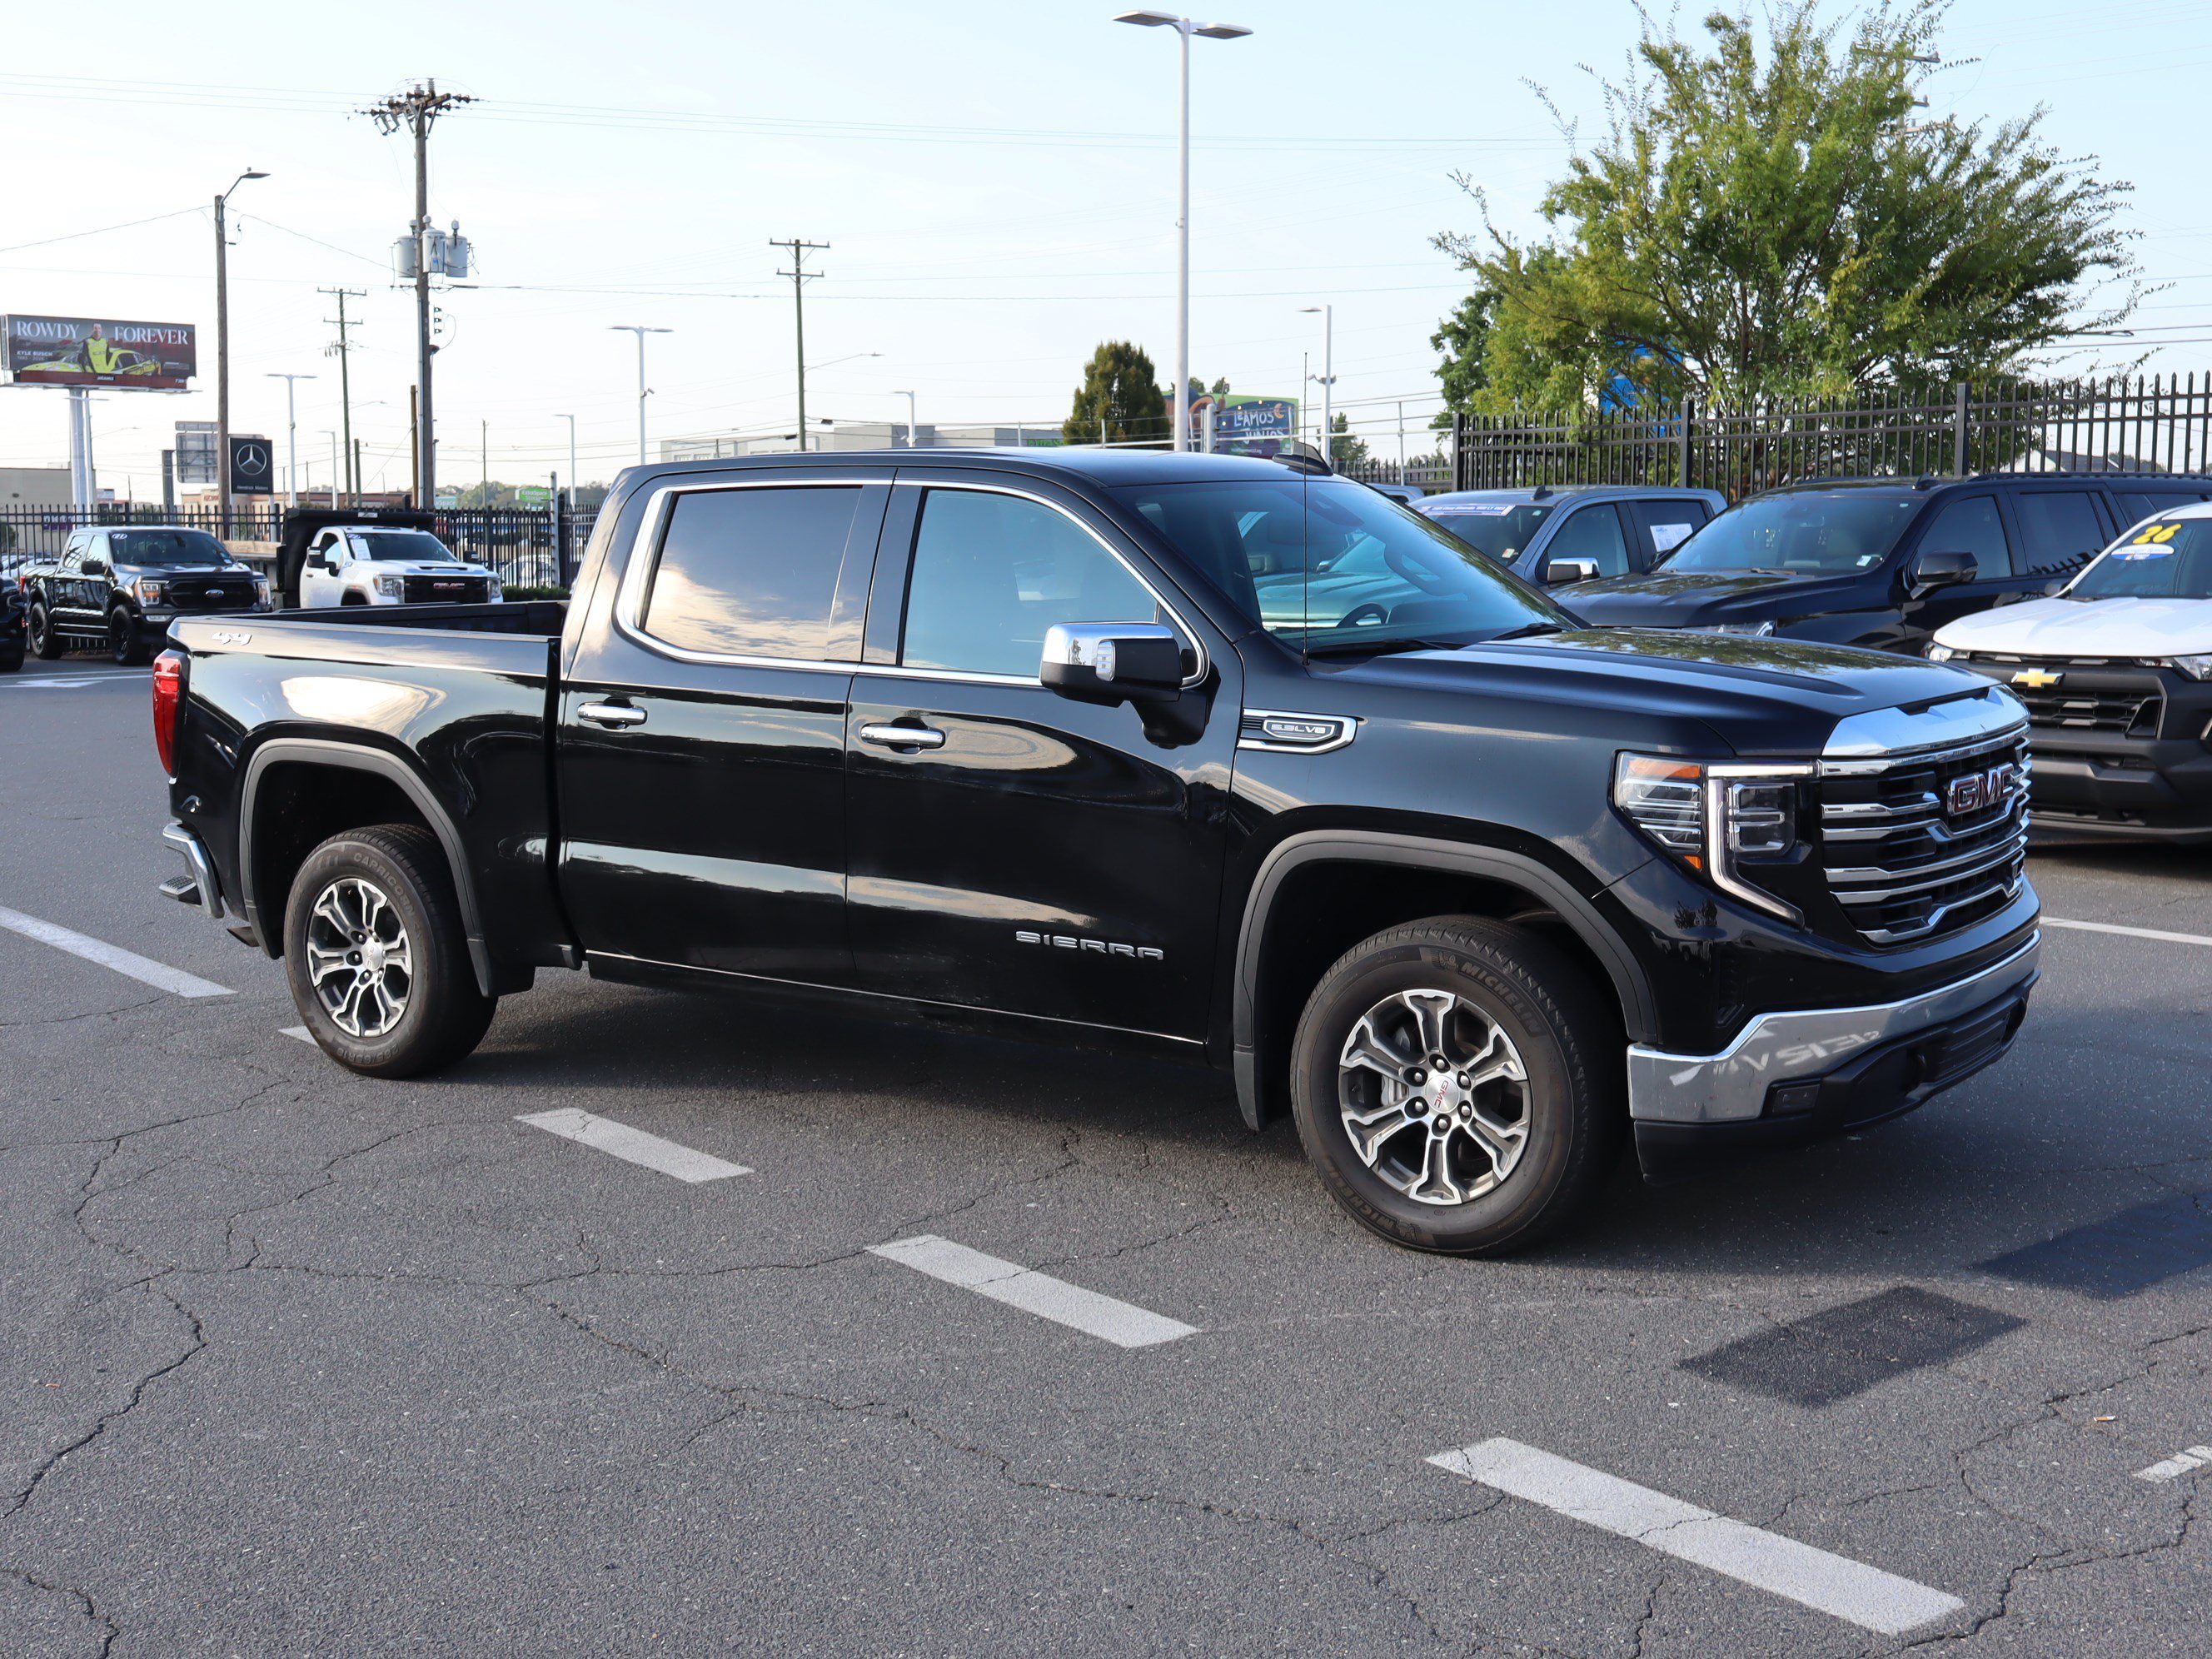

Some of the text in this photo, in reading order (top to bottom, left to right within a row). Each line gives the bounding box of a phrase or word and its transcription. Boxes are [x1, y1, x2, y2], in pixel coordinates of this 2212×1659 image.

[17, 321, 188, 345] ROWDY FOREVER
[2133, 523, 2182, 544] 26
[1948, 763, 2014, 815] GMC
[1016, 930, 1163, 960] SIERRA
[1461, 961, 1542, 1035] MICHELIN
[1432, 1079, 1450, 1108] GMC
